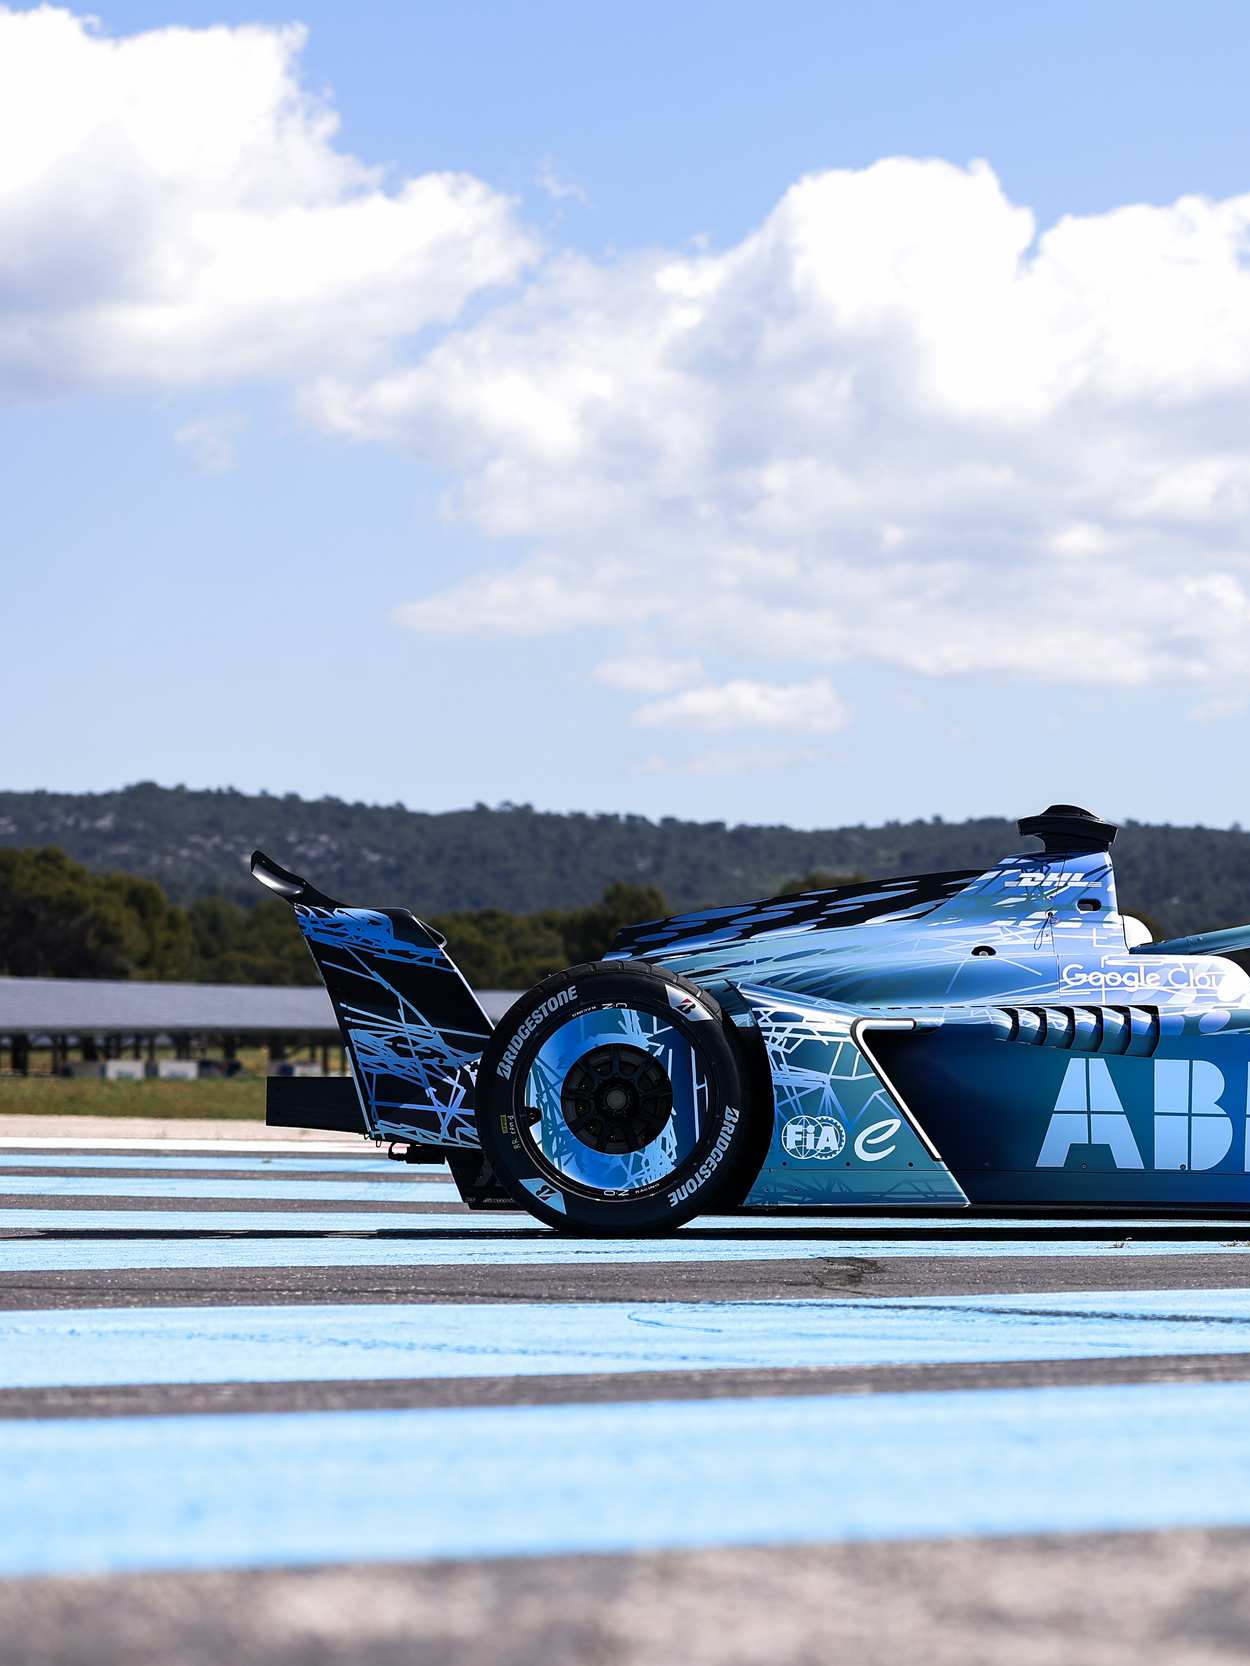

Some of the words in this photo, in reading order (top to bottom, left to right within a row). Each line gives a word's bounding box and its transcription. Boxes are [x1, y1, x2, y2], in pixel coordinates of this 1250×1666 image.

[1017, 872, 1090, 887] DHL
[1062, 963, 1161, 993] Google
[496, 985, 578, 1081] BRIDGESTONE
[667, 1104, 740, 1208] BRIDGESTONE
